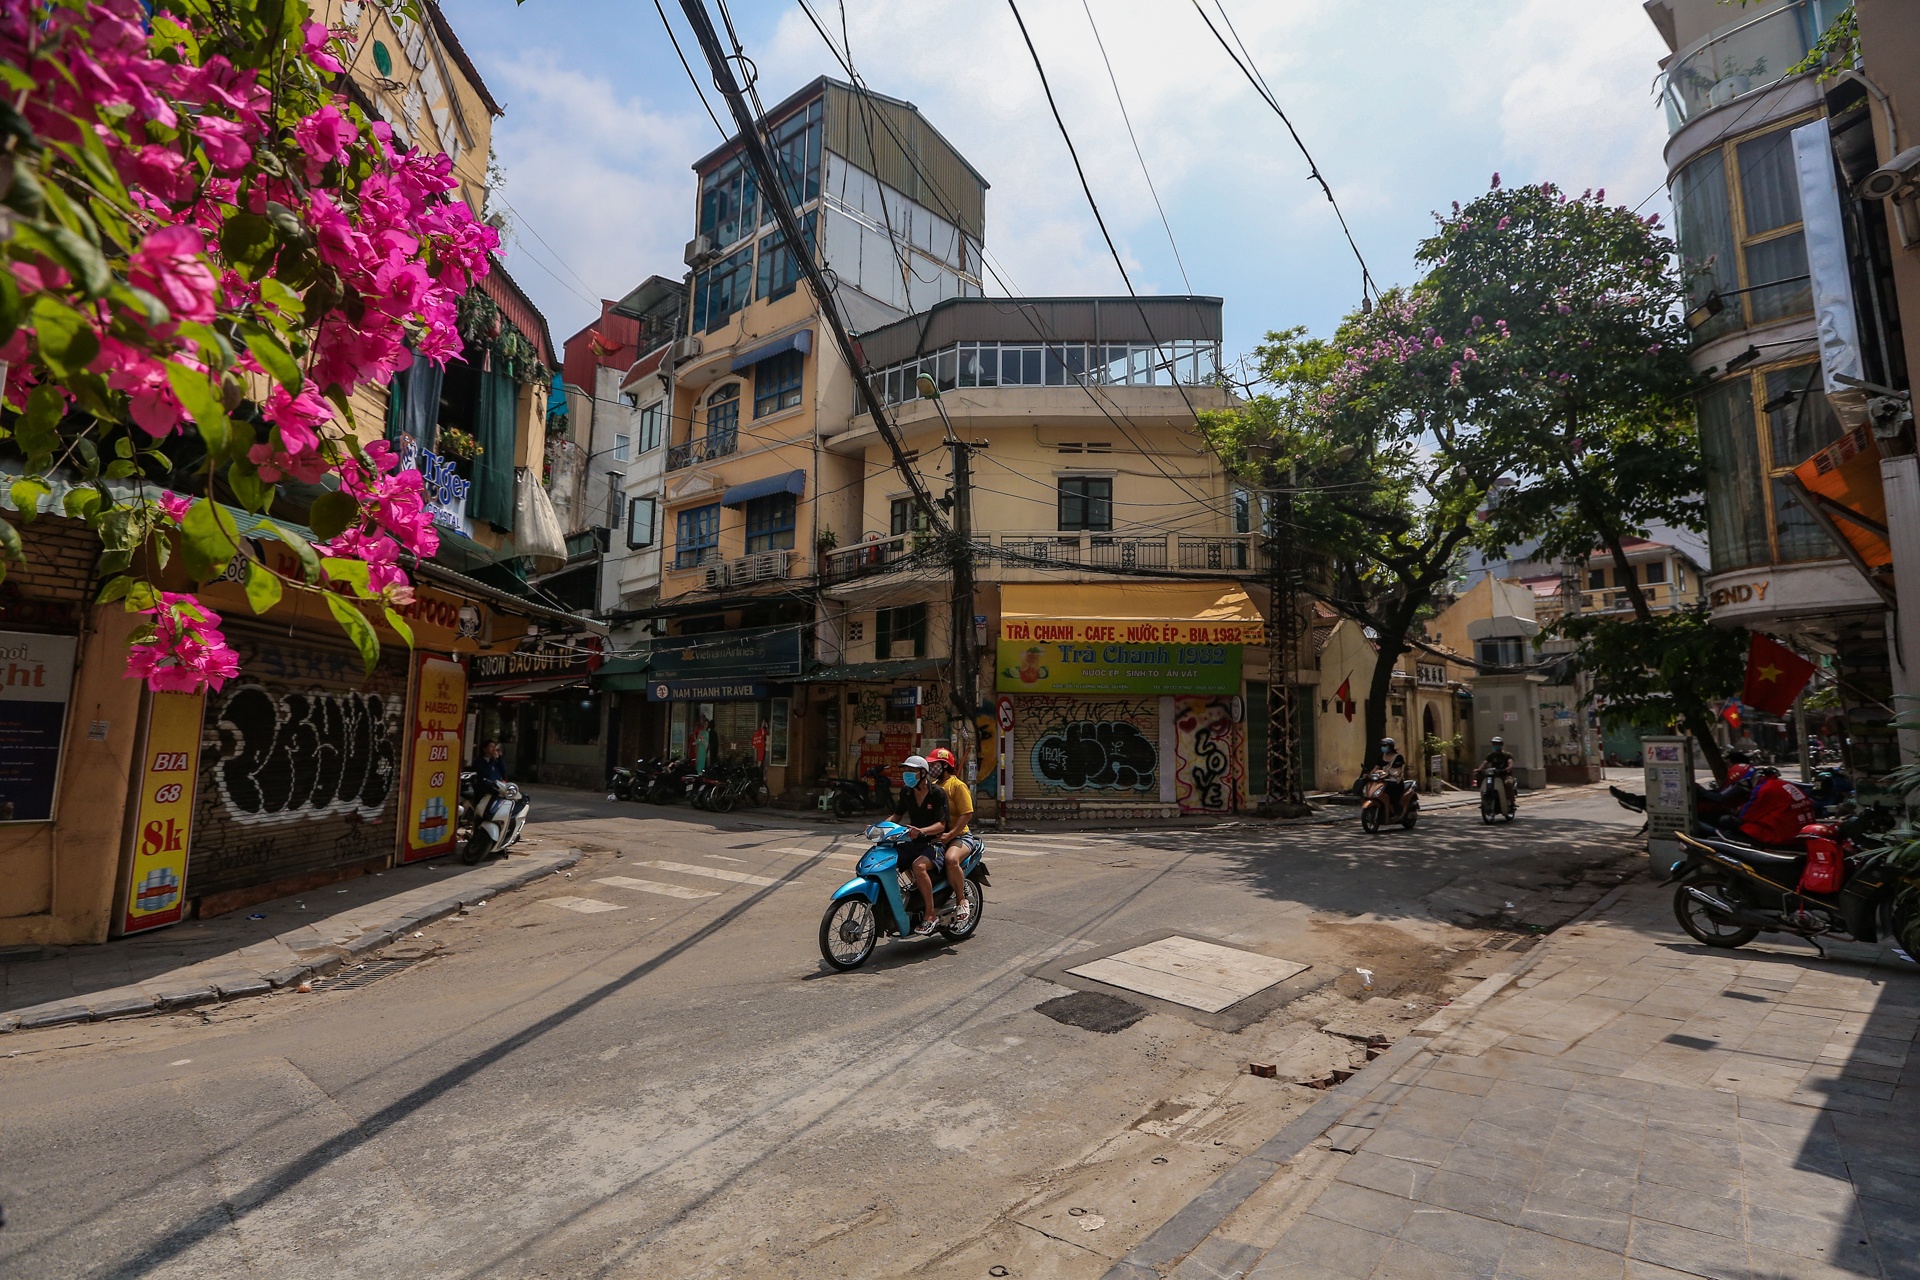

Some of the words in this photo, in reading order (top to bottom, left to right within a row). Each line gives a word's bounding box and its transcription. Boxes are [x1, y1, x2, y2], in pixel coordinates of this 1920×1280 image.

[422, 447, 471, 505] Tiger
[1006, 624, 1030, 640] TRÀ
[1034, 625, 1073, 640] CHANH
[1084, 626, 1115, 641] CAFE
[1127, 623, 1158, 641] NƯỚC
[1162, 624, 1179, 641] ÉP
[1189, 628, 1209, 642] BIA
[1213, 628, 1241, 642] 1982
[1057, 645, 1097, 663] Trà
[1102, 645, 1169, 664] Chanh
[1177, 646, 1227, 665] 1982
[0, 664, 46, 690] ght
[672, 687, 691, 698] NAM
[692, 687, 720, 697] THANH
[721, 685, 755, 697] TRAVEL
[424, 701, 458, 715] HABECO
[426, 719, 444, 742] 8k
[153, 752, 189, 772] BIA
[429, 747, 448, 761] BIA
[430, 771, 445, 788] 68
[155, 783, 183, 804] 68
[141, 817, 183, 857] 8k
